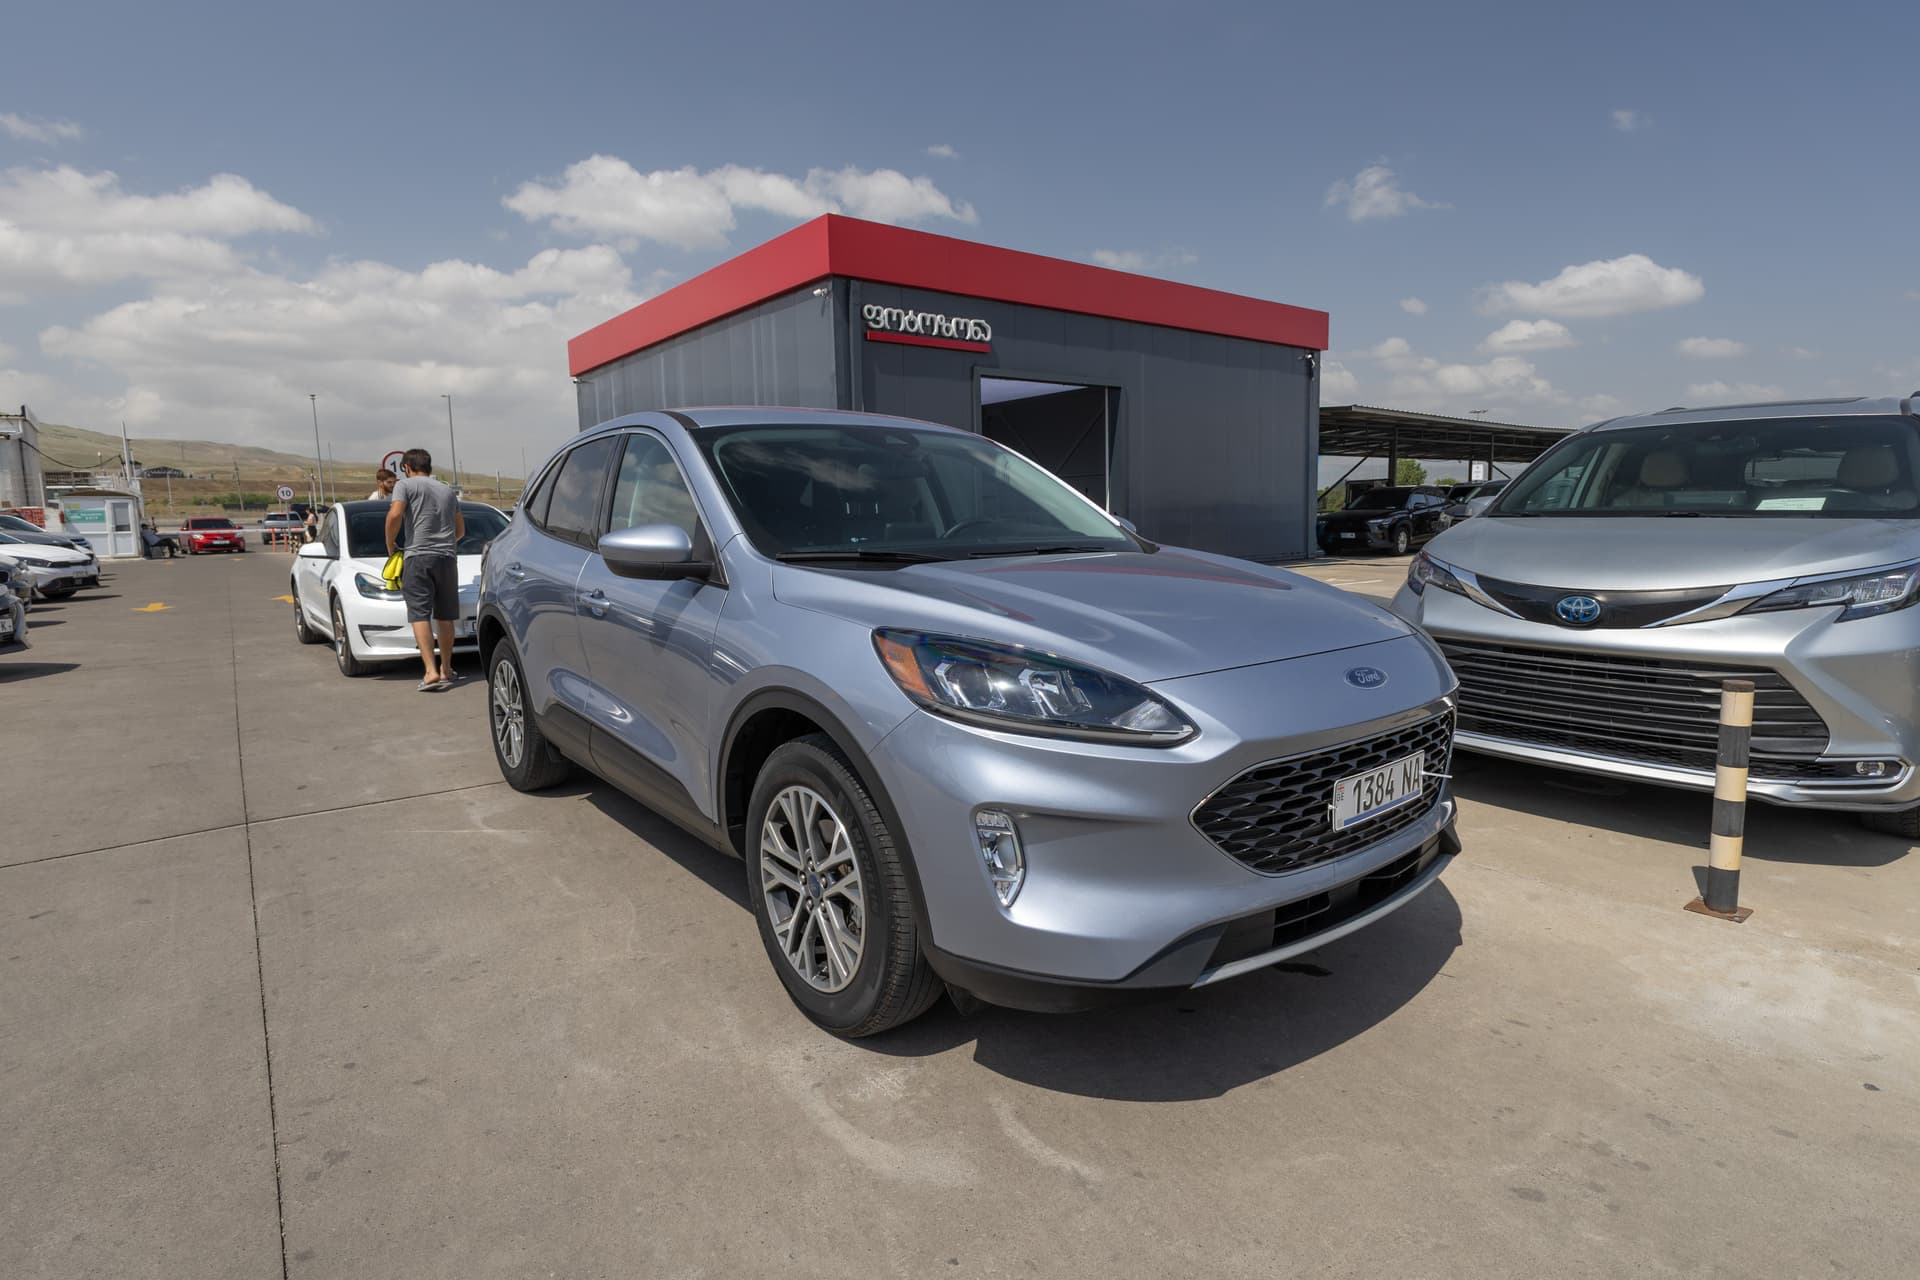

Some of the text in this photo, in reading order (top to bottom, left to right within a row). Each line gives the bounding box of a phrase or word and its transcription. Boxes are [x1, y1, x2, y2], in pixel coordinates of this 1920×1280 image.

[864, 304, 992, 341] ფოტოზონა
[1355, 670, 1380, 684] Ford
[1353, 757, 1420, 814] 1384 NA
